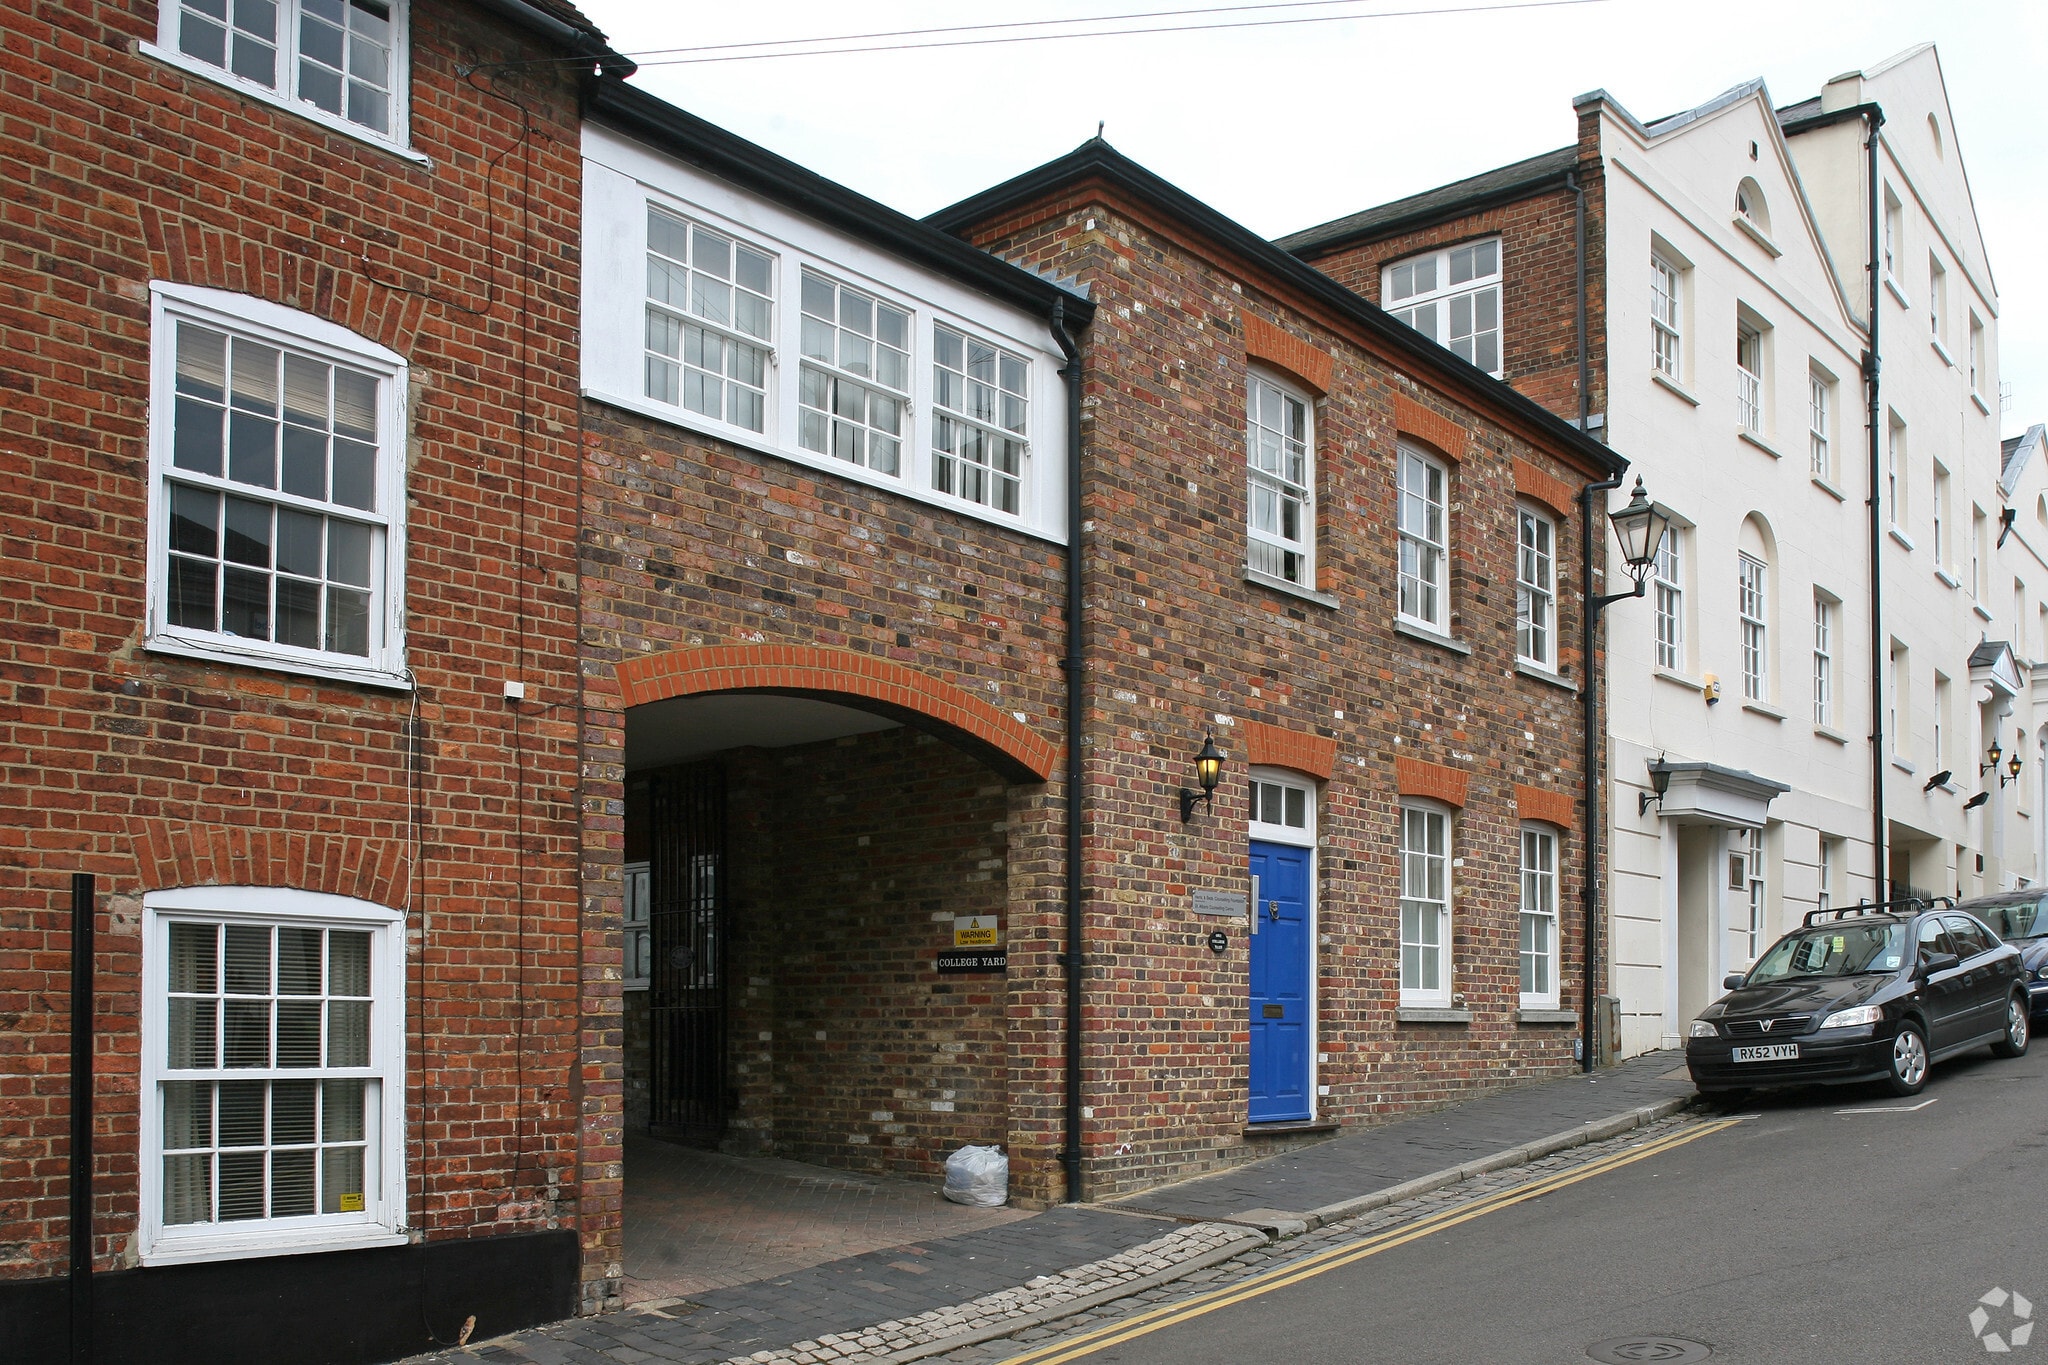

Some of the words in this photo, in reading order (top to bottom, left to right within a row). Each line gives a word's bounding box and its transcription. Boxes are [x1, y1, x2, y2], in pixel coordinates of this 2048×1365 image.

[960, 930, 991, 938] WARNING
[939, 958, 978, 967] COLLEGE
[982, 957, 1006, 966] YARD
[1740, 1047, 1770, 1059] RX52
[1773, 1045, 1797, 1056] VYH
